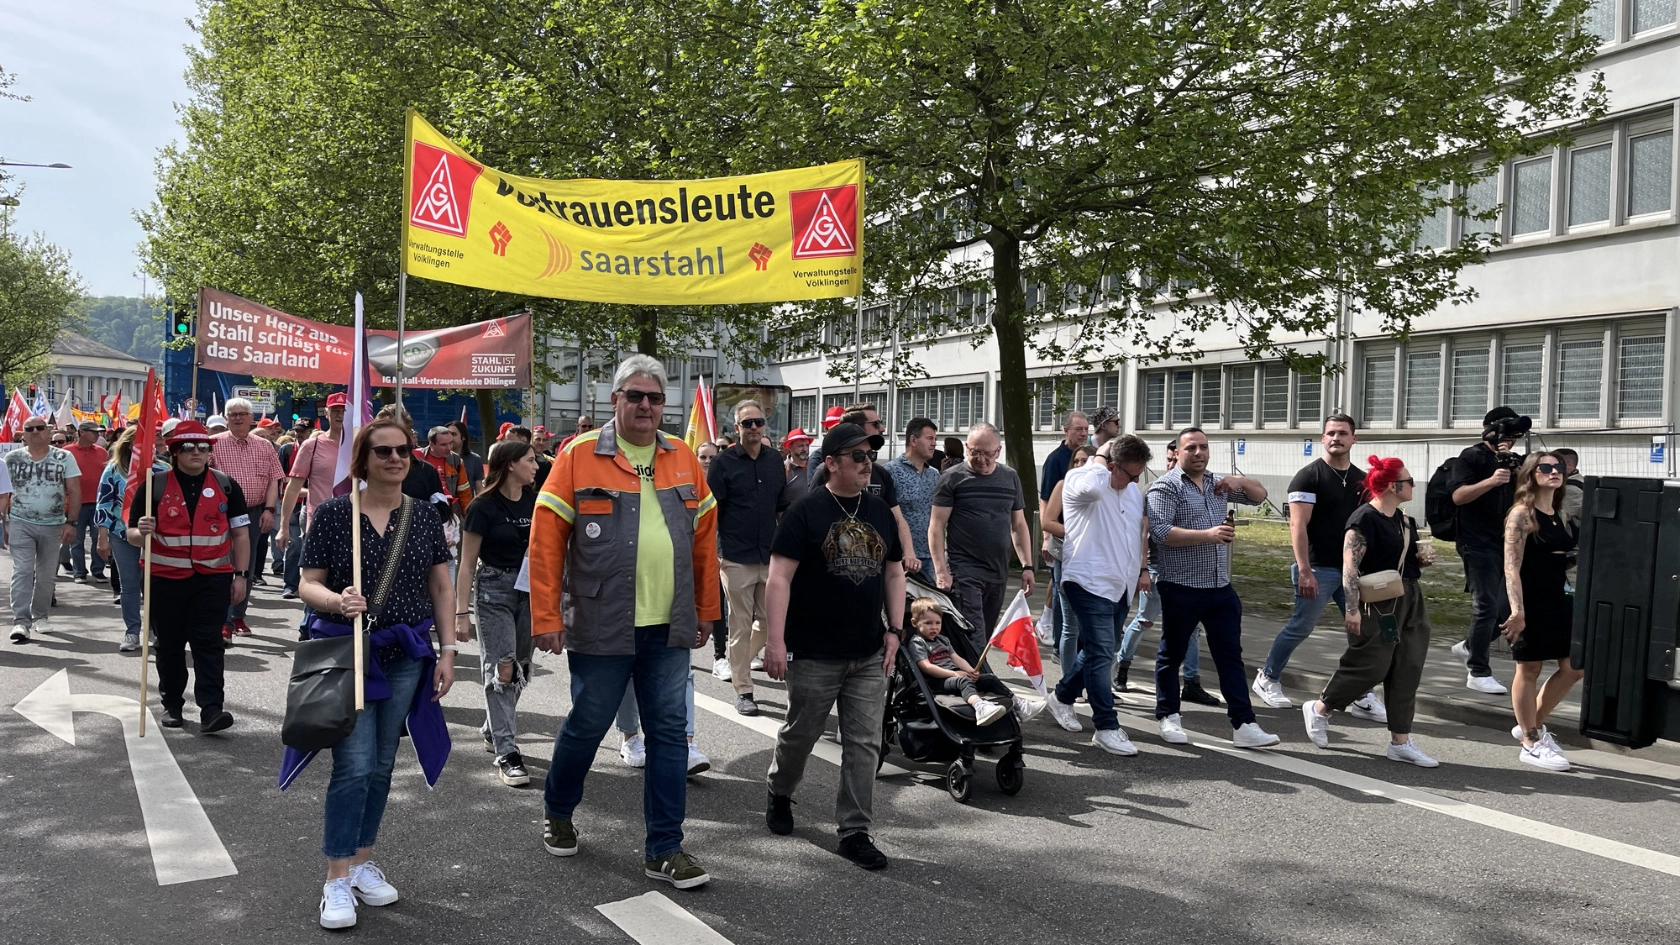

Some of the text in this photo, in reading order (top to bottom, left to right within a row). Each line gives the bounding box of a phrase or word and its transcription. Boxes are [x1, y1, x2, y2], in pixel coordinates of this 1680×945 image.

[413, 252, 450, 269] Völklingen
[580, 246, 725, 276] saarstahl
[792, 267, 857, 278] Verwaltungstelle
[805, 277, 850, 287] Völklingen
[209, 301, 339, 344] Unser Herz aus
[207, 321, 350, 356] Stahl schlägt für
[206, 341, 319, 369] das Saarland
[471, 365, 516, 373] ZUKUNFT
[382, 376, 391, 384] IG
[483, 377, 517, 387] Dillinger
